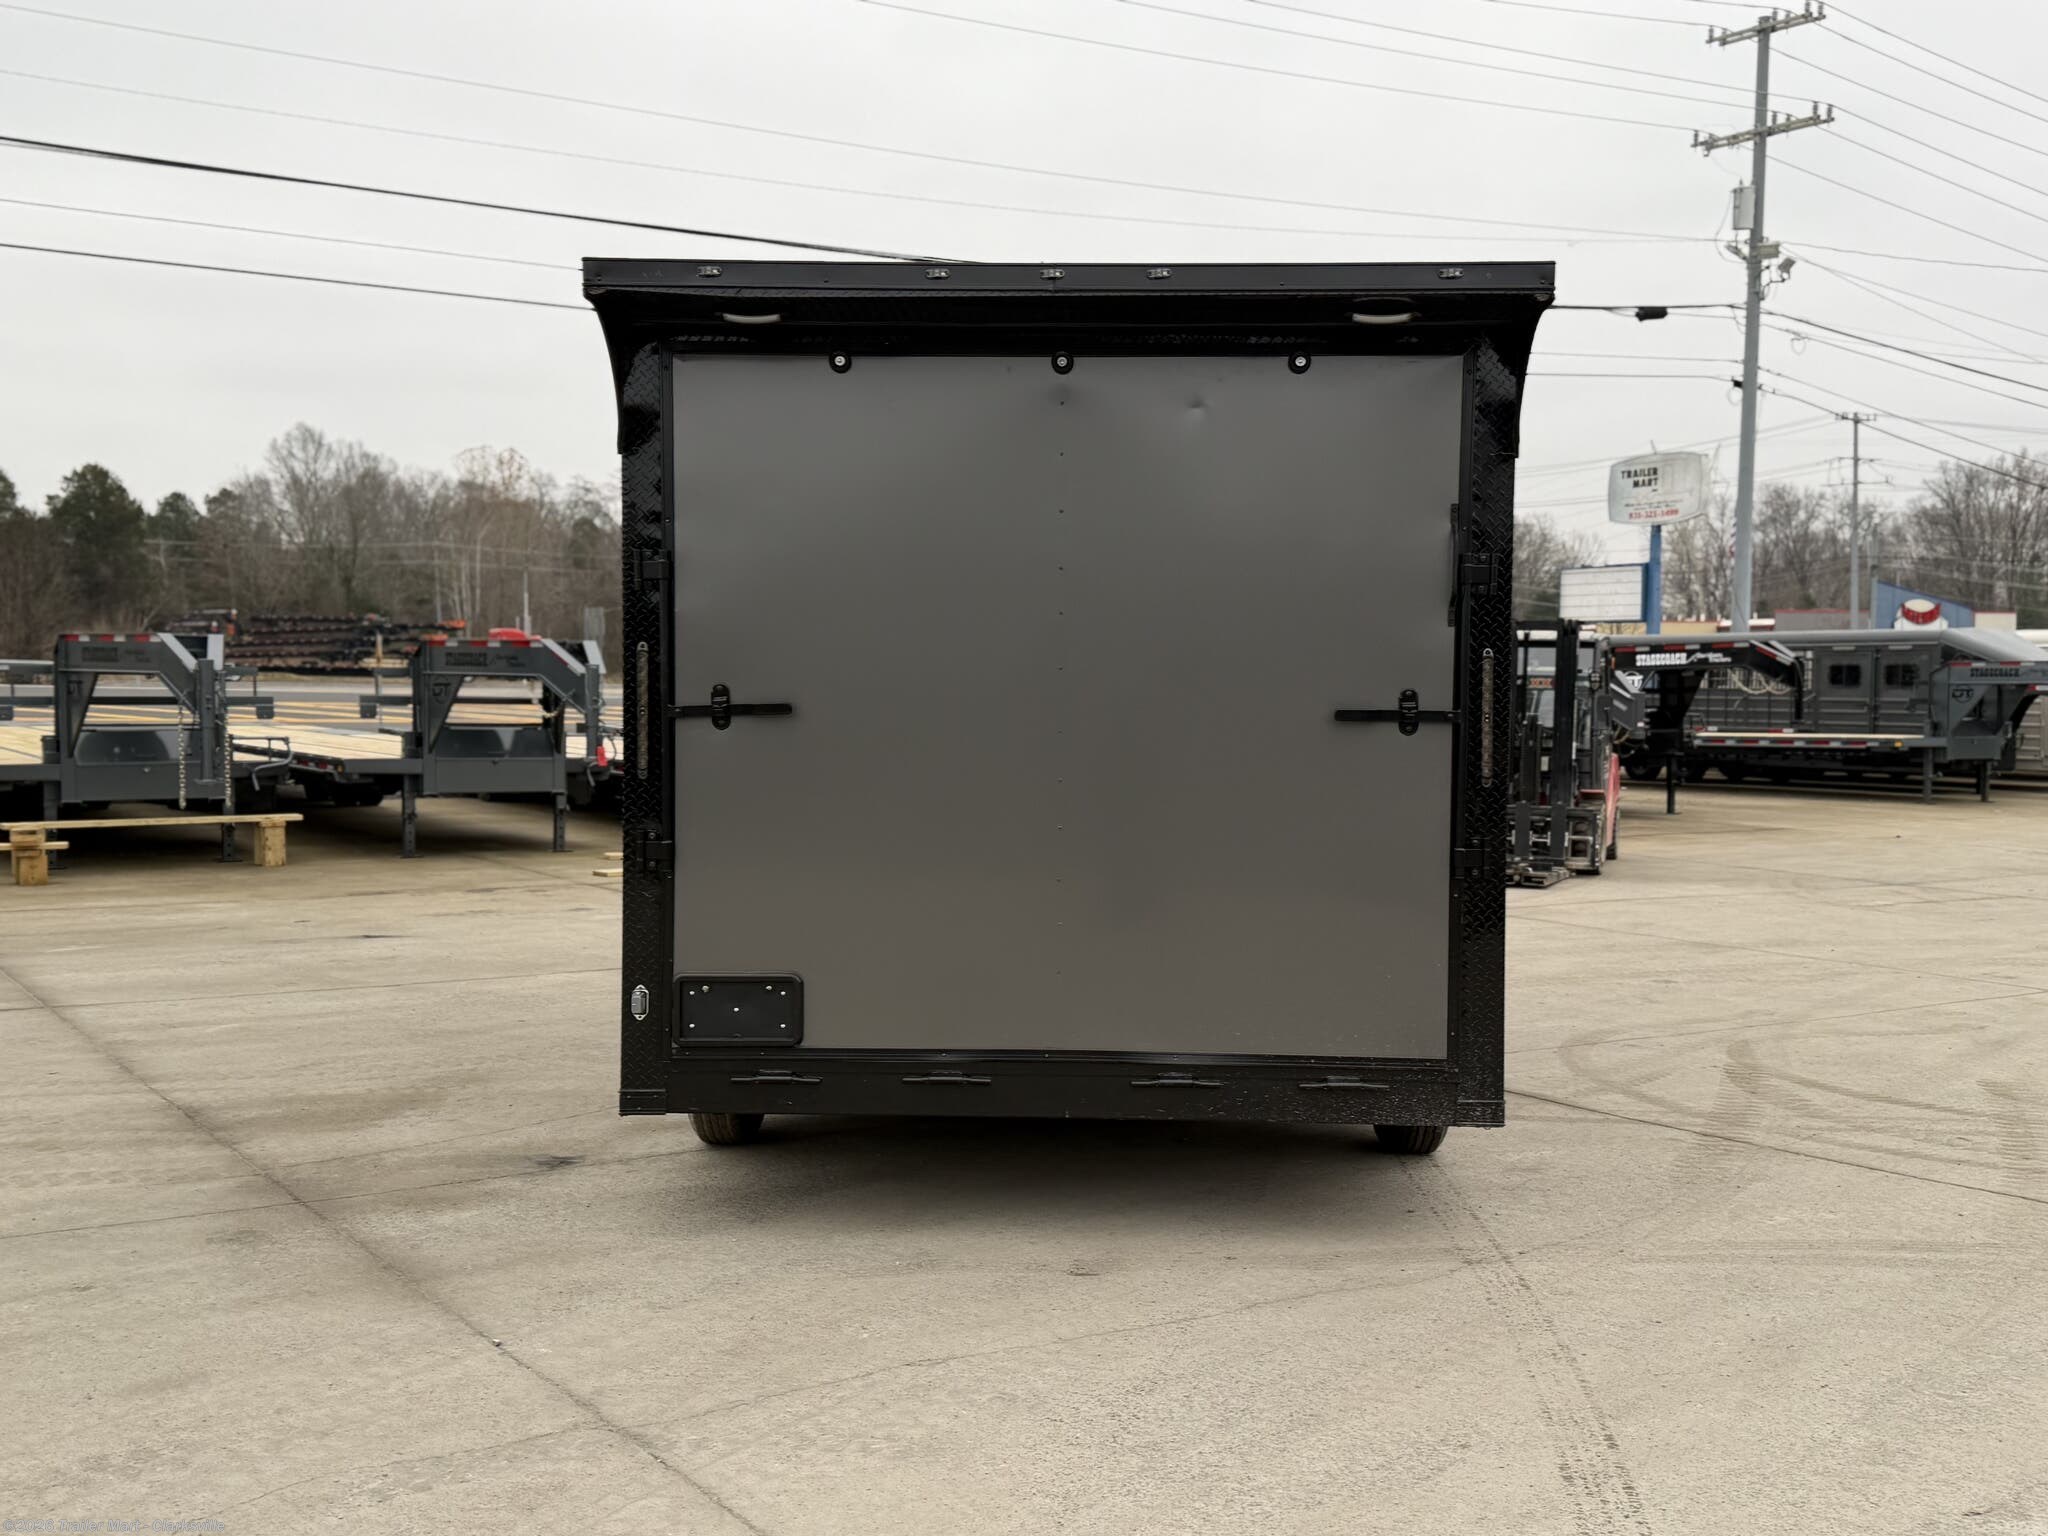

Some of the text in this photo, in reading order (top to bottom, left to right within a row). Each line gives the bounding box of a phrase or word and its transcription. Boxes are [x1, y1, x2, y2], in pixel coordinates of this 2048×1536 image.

[1621, 467, 1658, 479] TRAILER
[1632, 477, 1658, 488] MART
[1635, 652, 1687, 666] STAGECOACH
